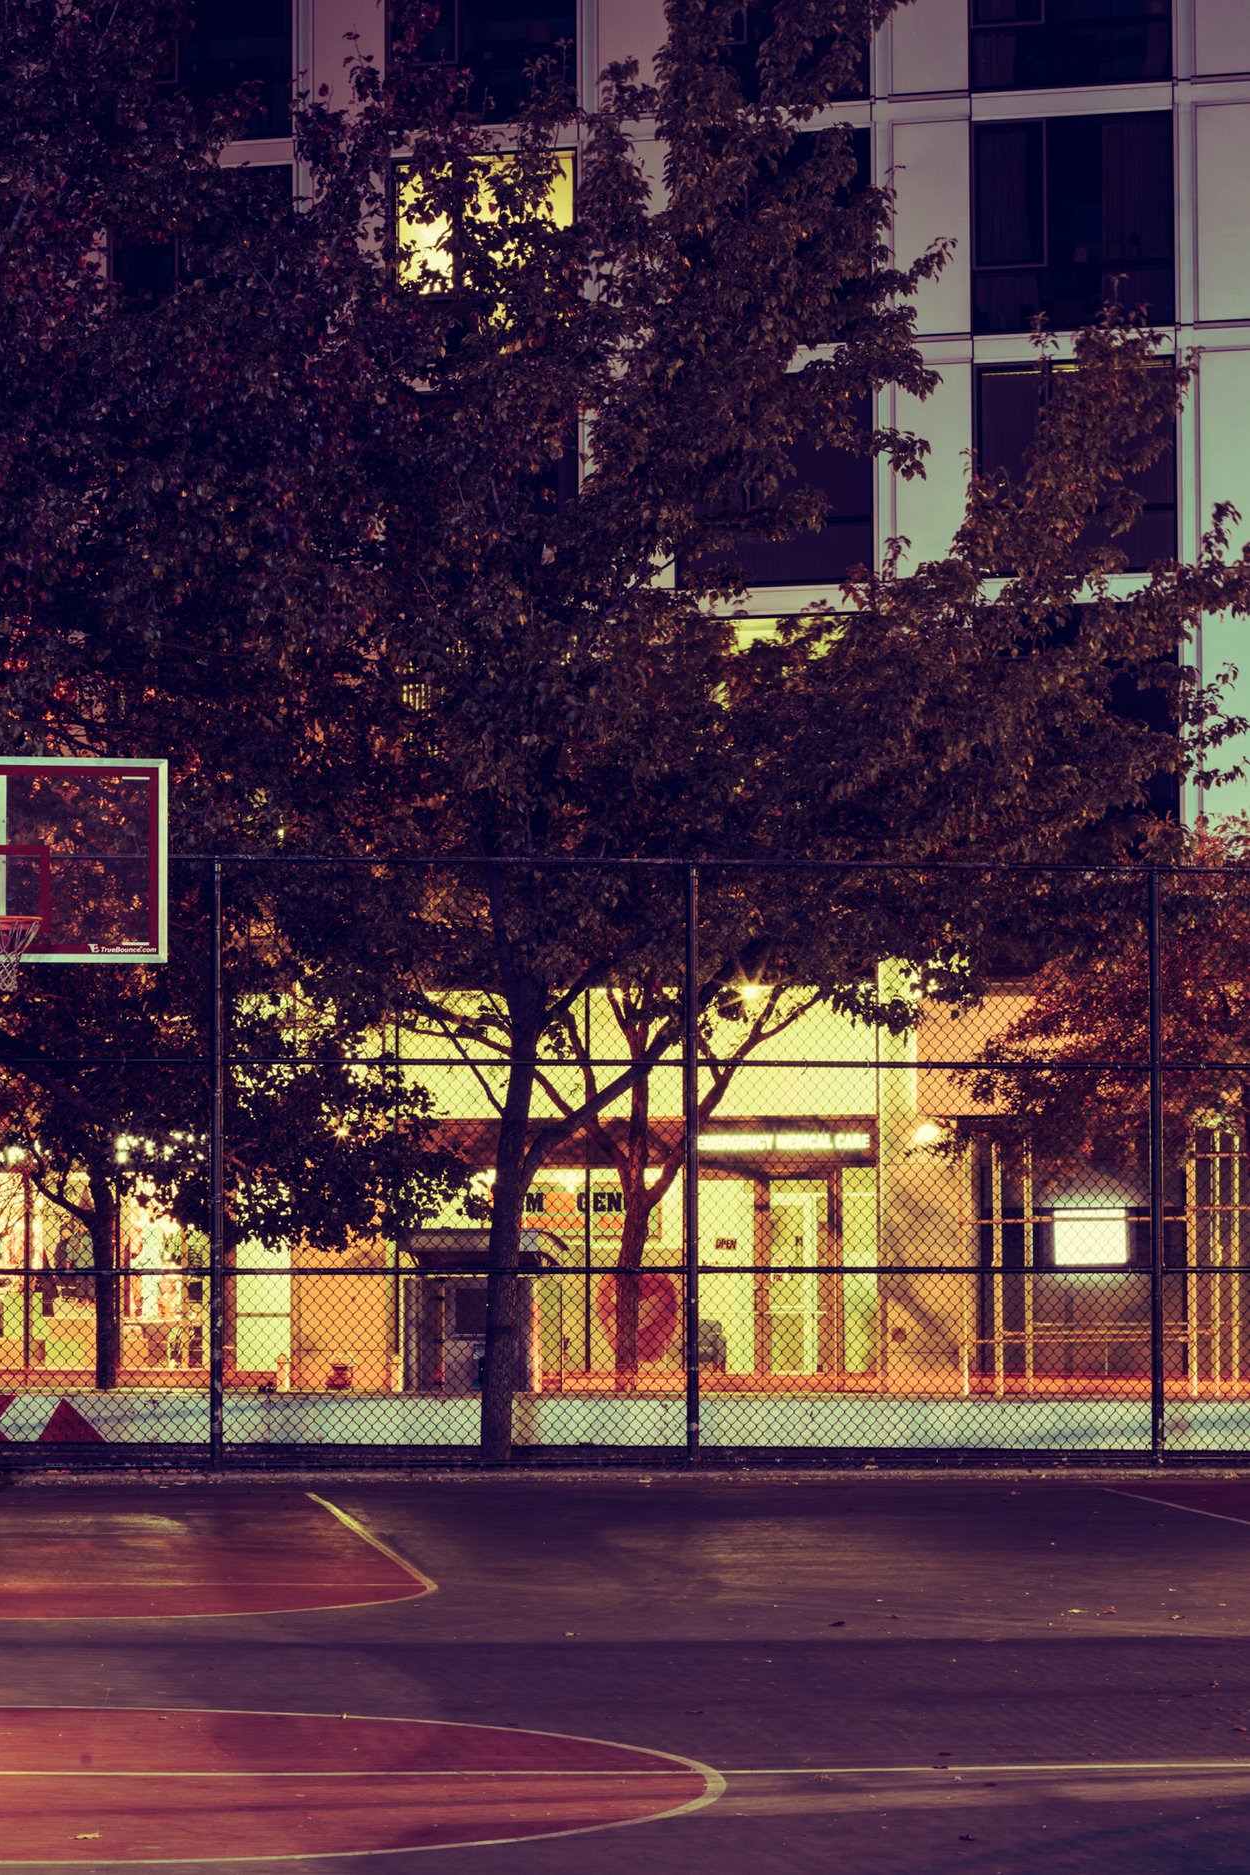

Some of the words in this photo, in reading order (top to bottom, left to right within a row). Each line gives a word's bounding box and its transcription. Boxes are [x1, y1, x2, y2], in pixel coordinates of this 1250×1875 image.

[697, 1134, 773, 1150] EMERGENCY
[776, 1133, 833, 1150] MEDICAL
[835, 1132, 870, 1149] CARE
[715, 1238, 737, 1250] OPEN
